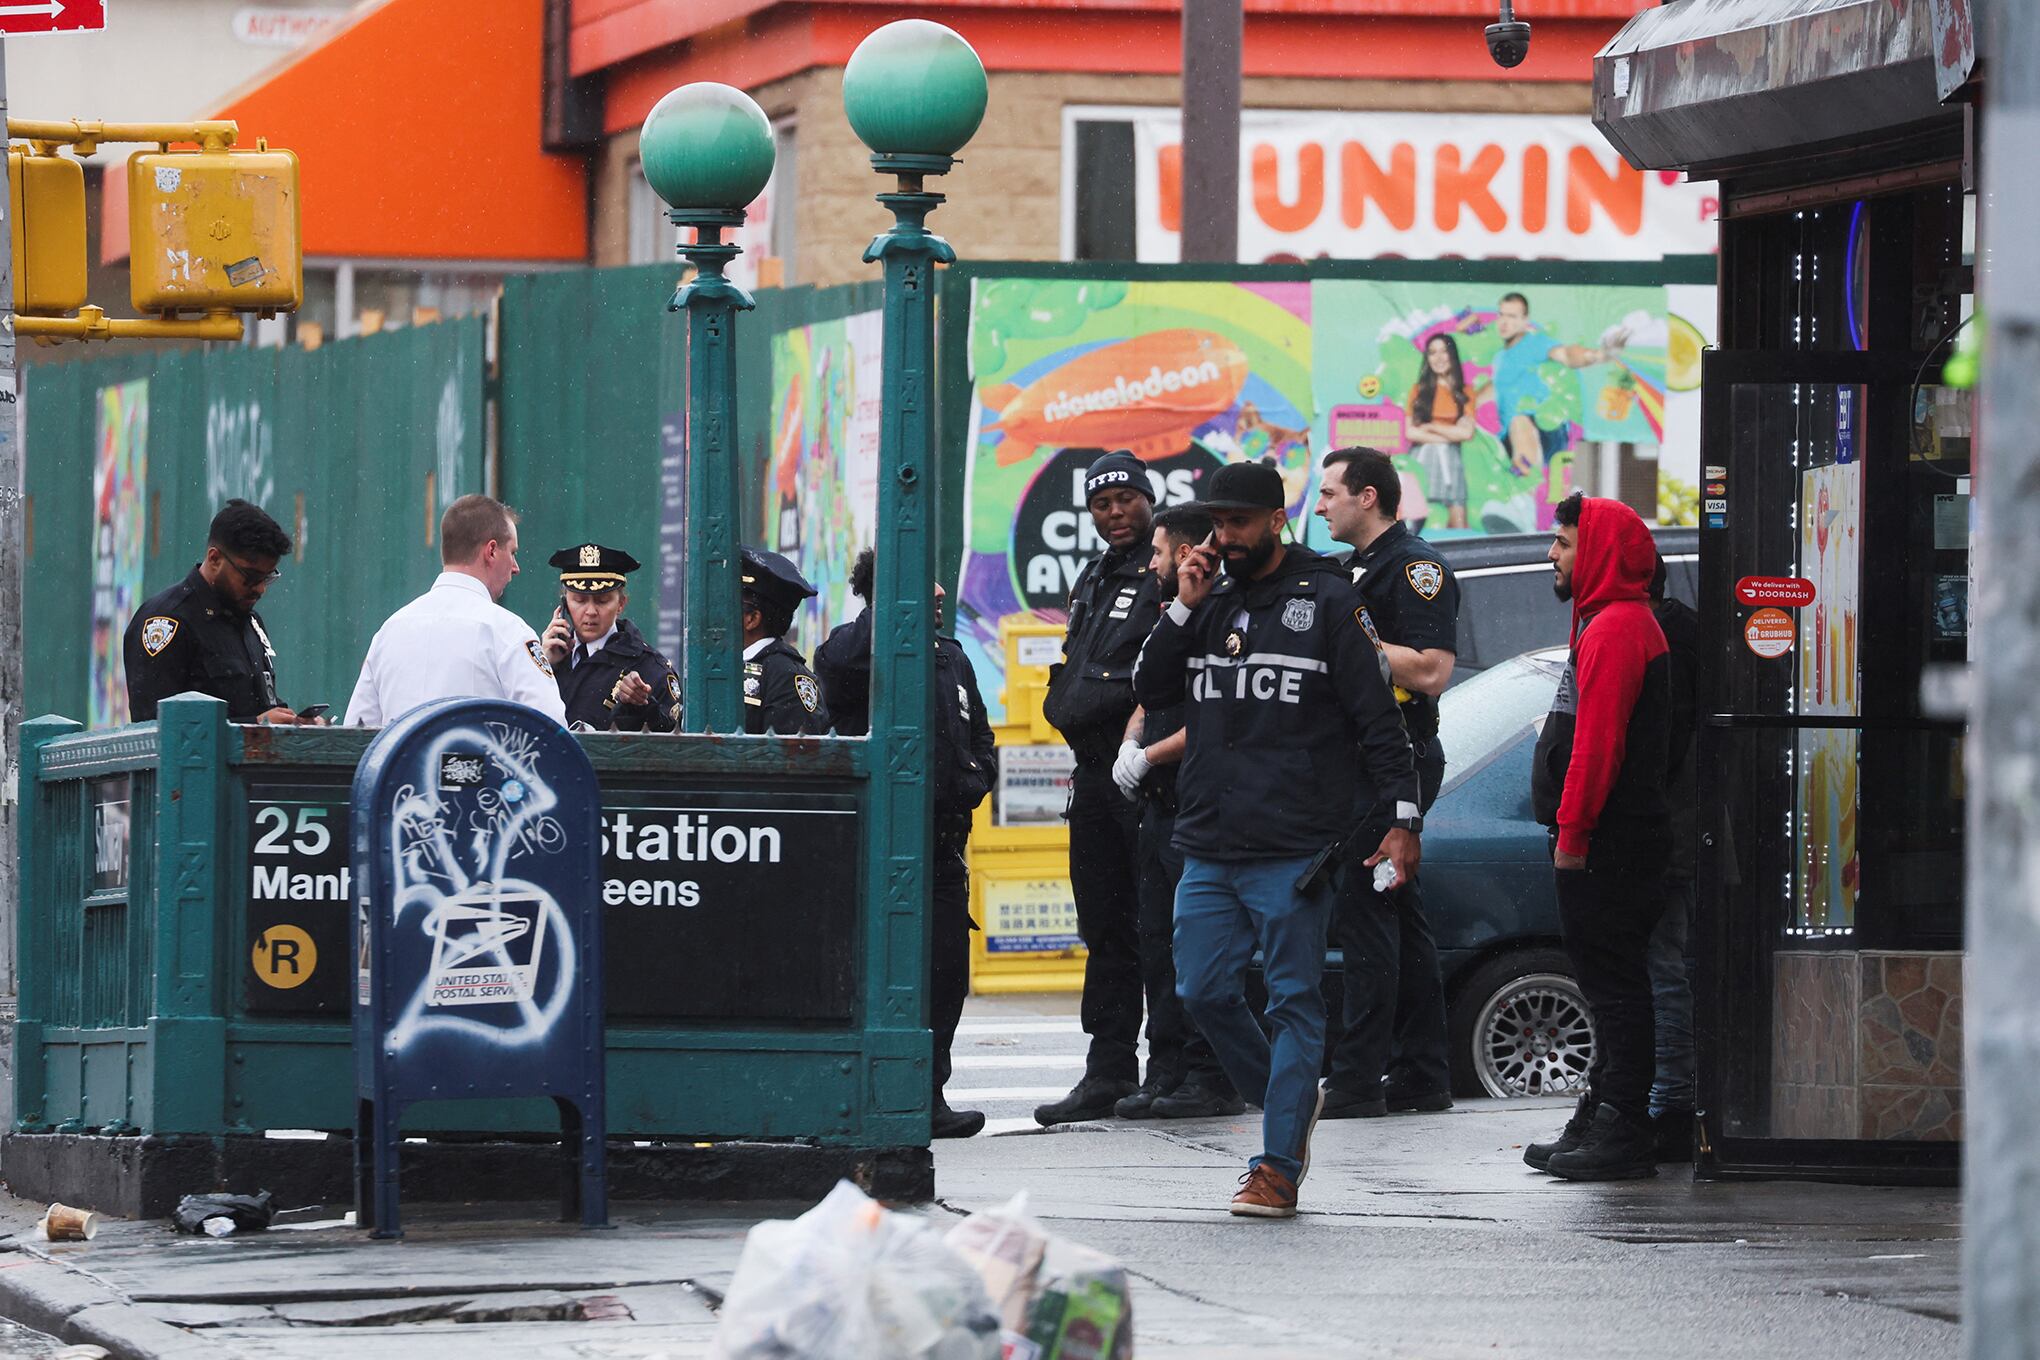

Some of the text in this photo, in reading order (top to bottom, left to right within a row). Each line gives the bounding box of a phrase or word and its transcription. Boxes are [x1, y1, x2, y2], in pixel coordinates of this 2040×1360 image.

[1044, 360, 1220, 423] nickelodeon
[1088, 470, 1130, 491] NYPD
[1707, 502, 1726, 510] VISA
[1758, 590, 1809, 599] DOORDASH
[1760, 630, 1793, 638] GRUBHUB
[1192, 667, 1303, 704] LICE
[253, 806, 331, 856] 25
[602, 813, 781, 864] tation
[270, 939, 300, 974] R
[436, 972, 525, 987] UNITED STAT
[433, 985, 518, 1000] POSTAL SERVI
